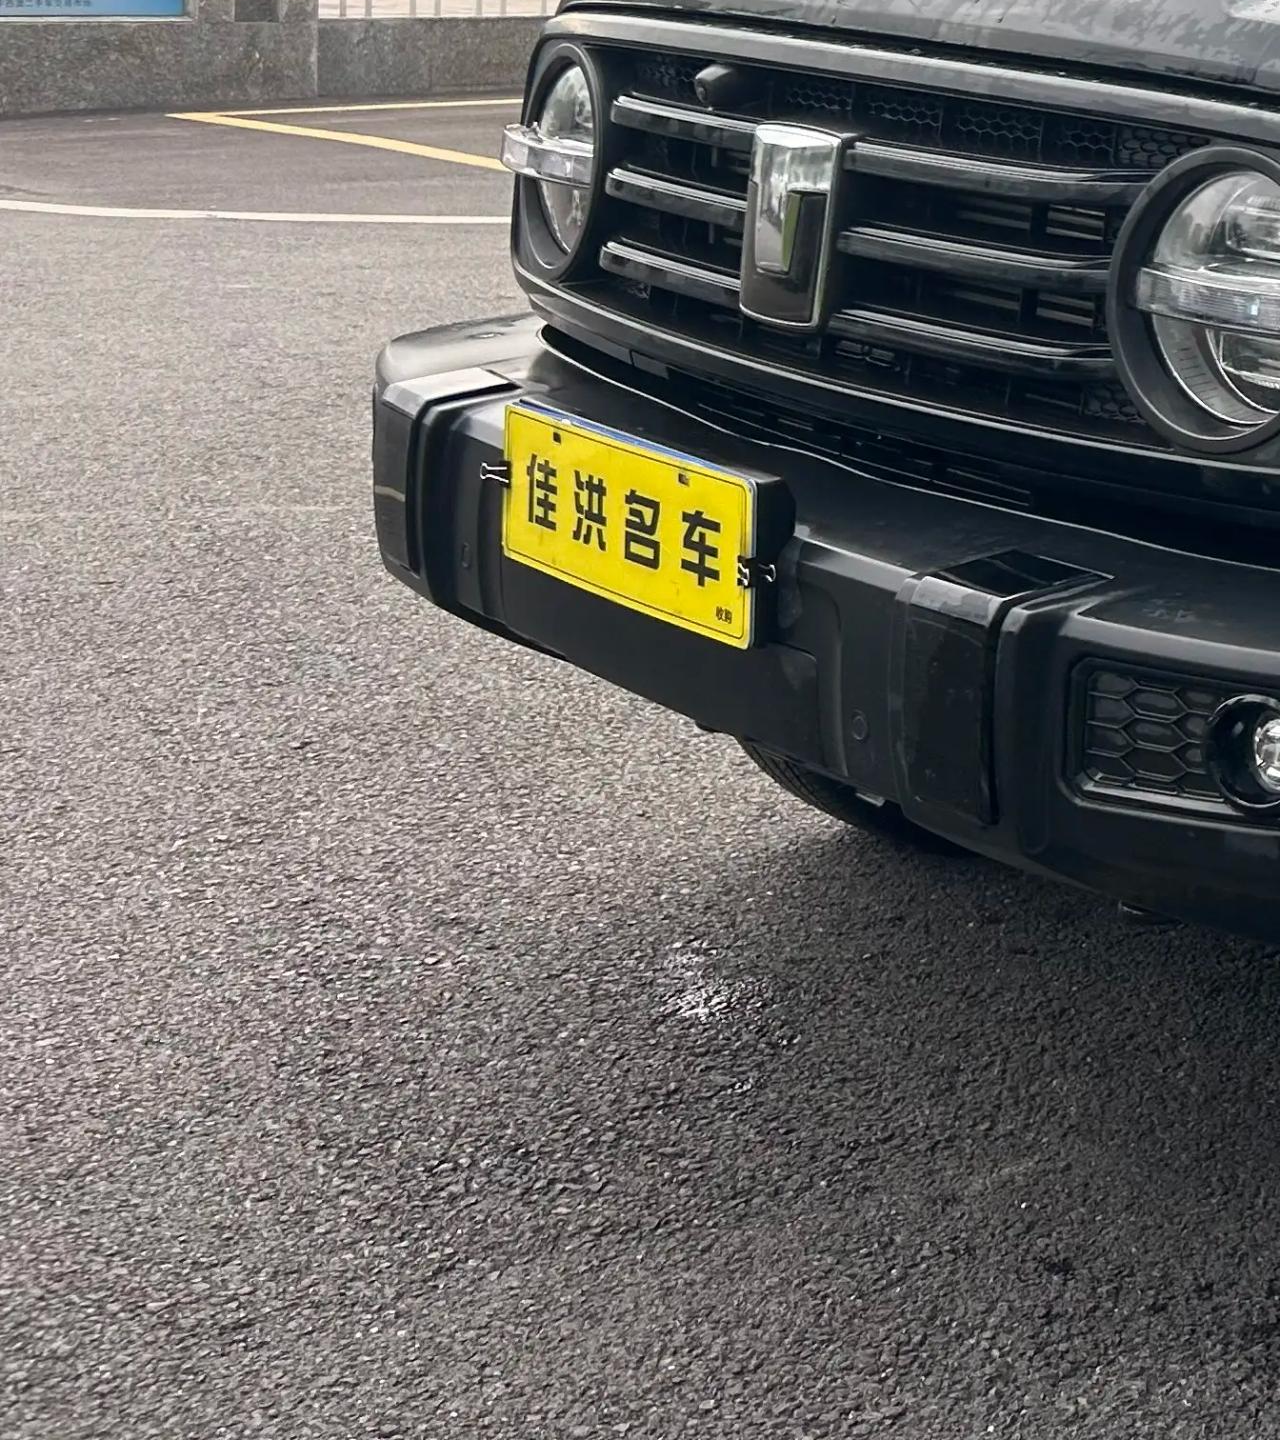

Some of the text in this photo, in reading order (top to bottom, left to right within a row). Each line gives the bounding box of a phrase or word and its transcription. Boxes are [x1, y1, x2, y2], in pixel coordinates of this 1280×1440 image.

[526, 453, 721, 588] 佳洪名车
[716, 606, 732, 624] 收购
